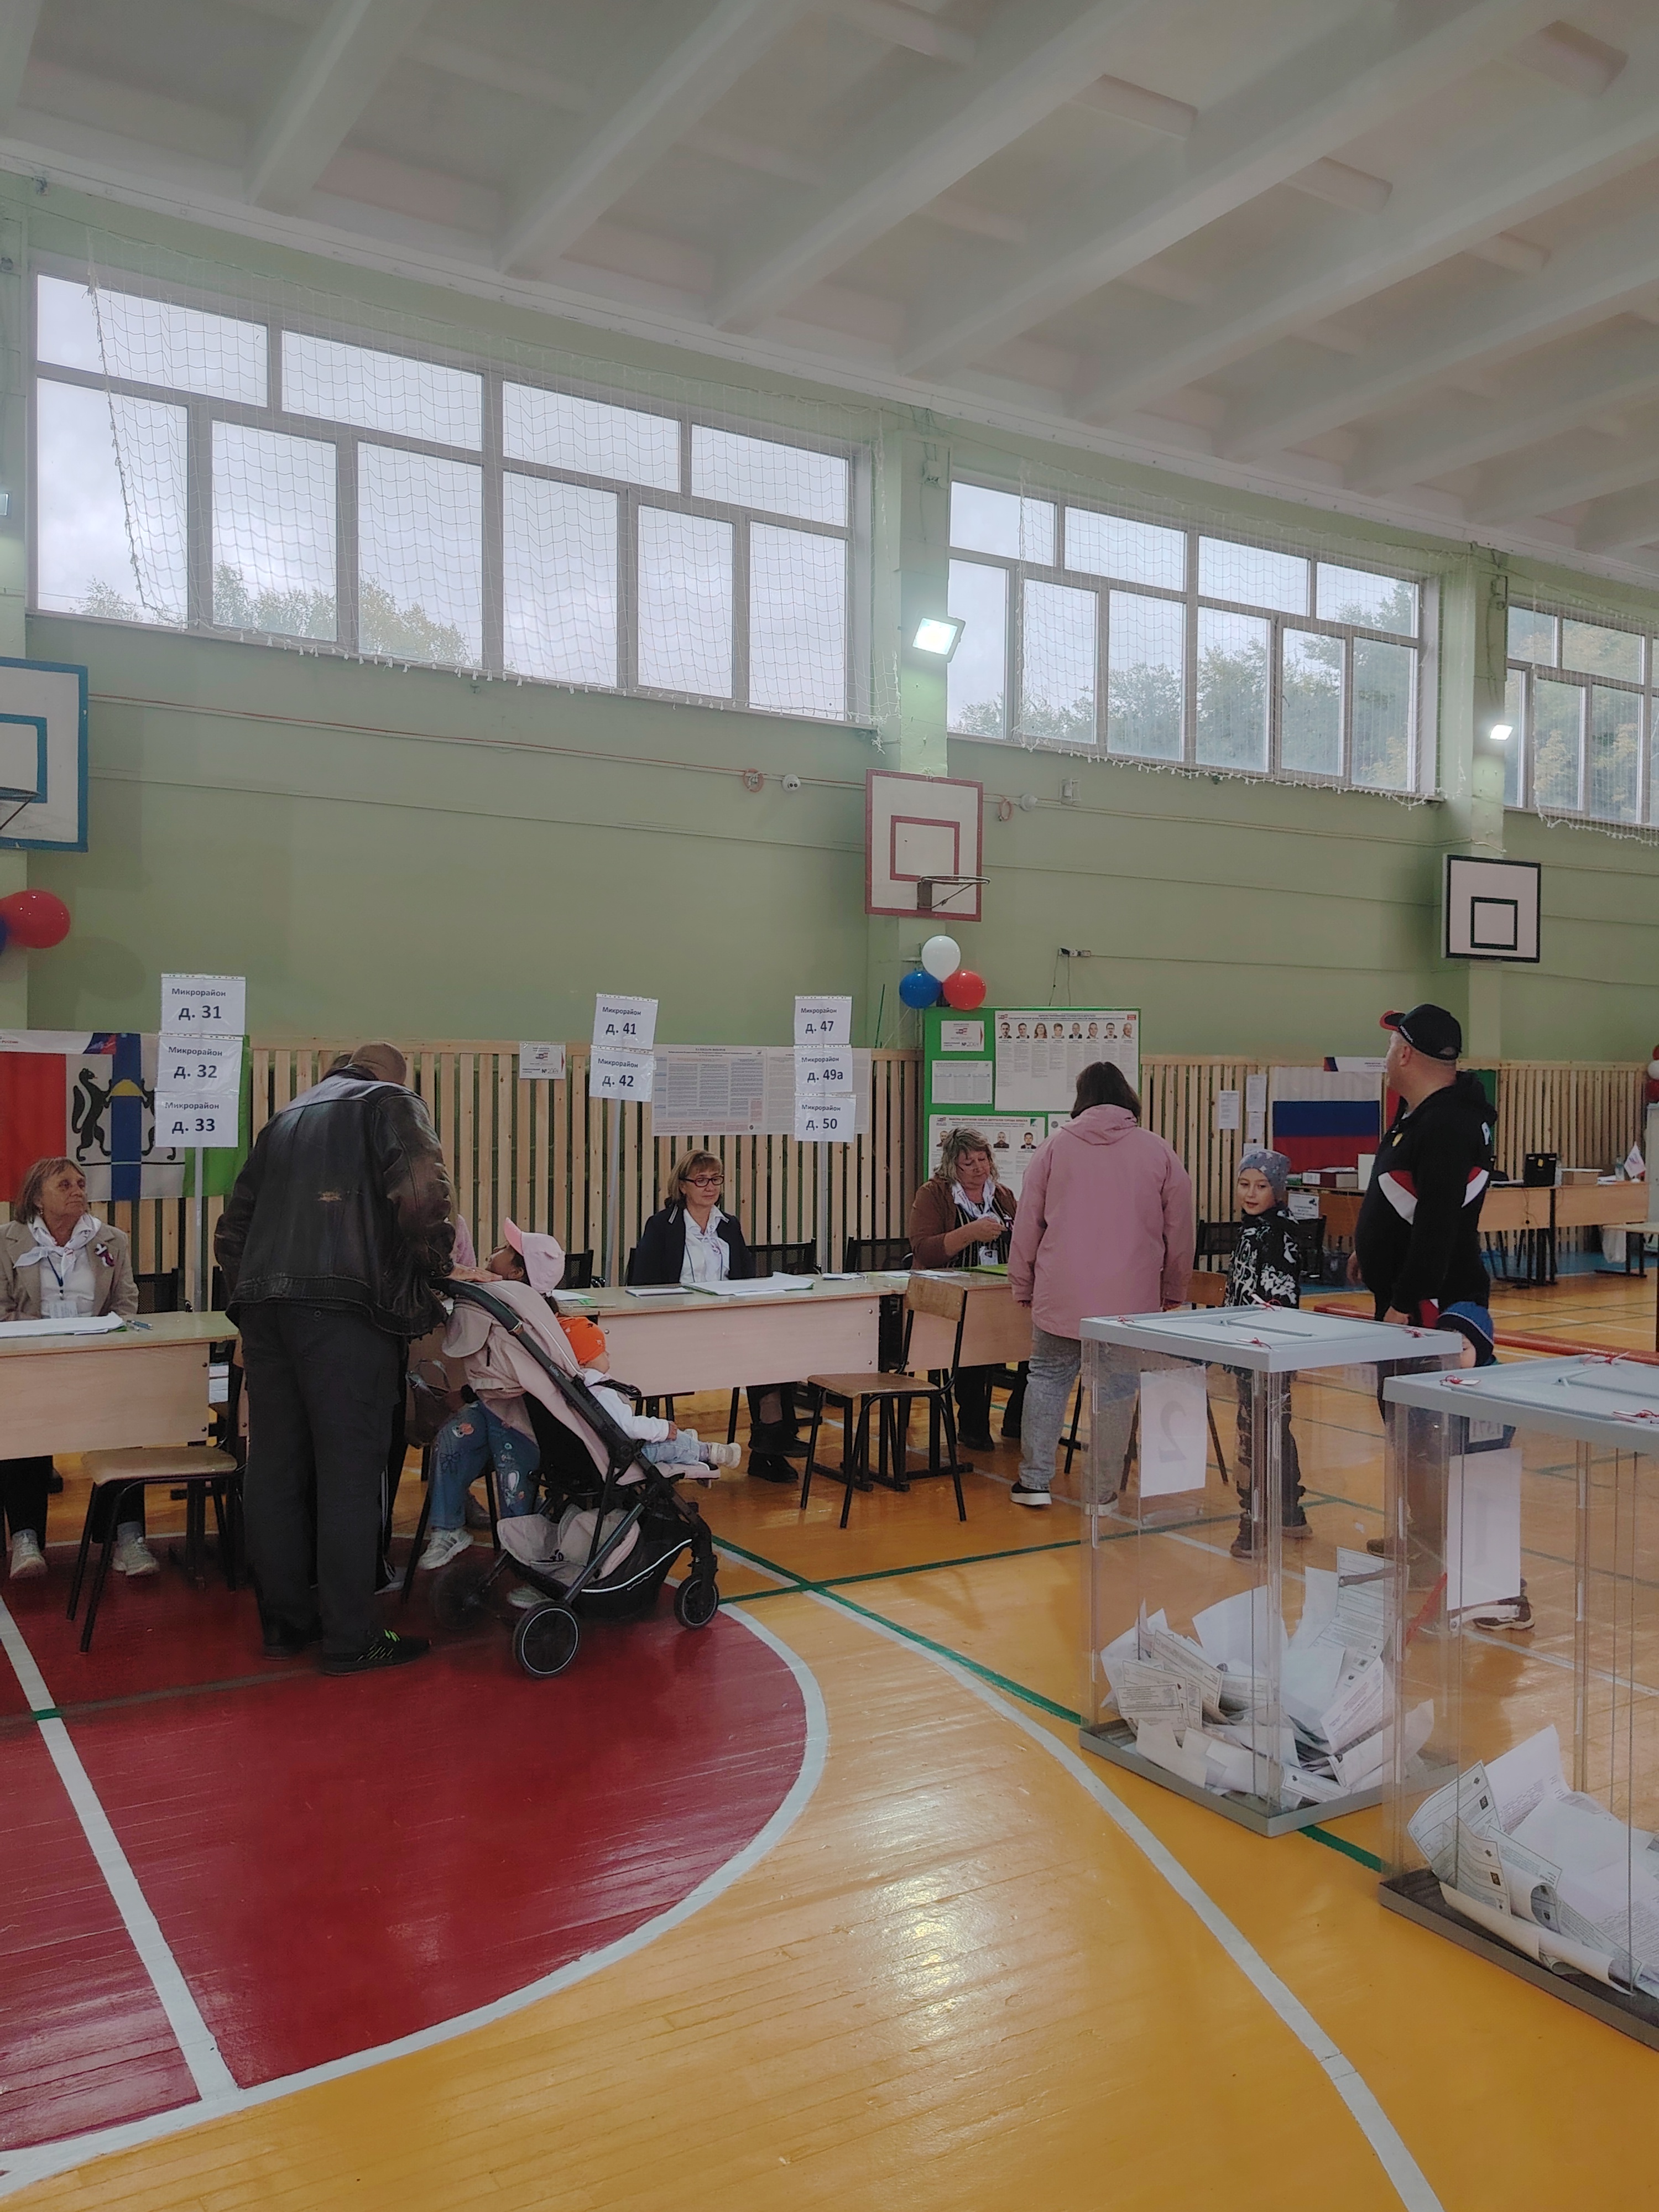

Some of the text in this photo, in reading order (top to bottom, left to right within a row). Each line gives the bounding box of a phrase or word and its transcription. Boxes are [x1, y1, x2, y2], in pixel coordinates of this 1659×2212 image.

[171, 988, 226, 997] Микрорайон
[178, 1005, 222, 1021] д. 31
[602, 1006, 641, 1016] Микрорайон
[606, 1022, 637, 1035] д. 41
[805, 1021, 834, 1034] д. 47
[168, 1046, 222, 1057] Микрорайон
[598, 1058, 638, 1068] Микрорайон
[174, 1065, 217, 1079] д. 32
[807, 1069, 843, 1083] д. 49а
[602, 1074, 634, 1087] д. 42
[165, 1102, 219, 1110] Микрорайон
[171, 1118, 215, 1134] д. 33
[806, 1118, 837, 1131] д. 50
